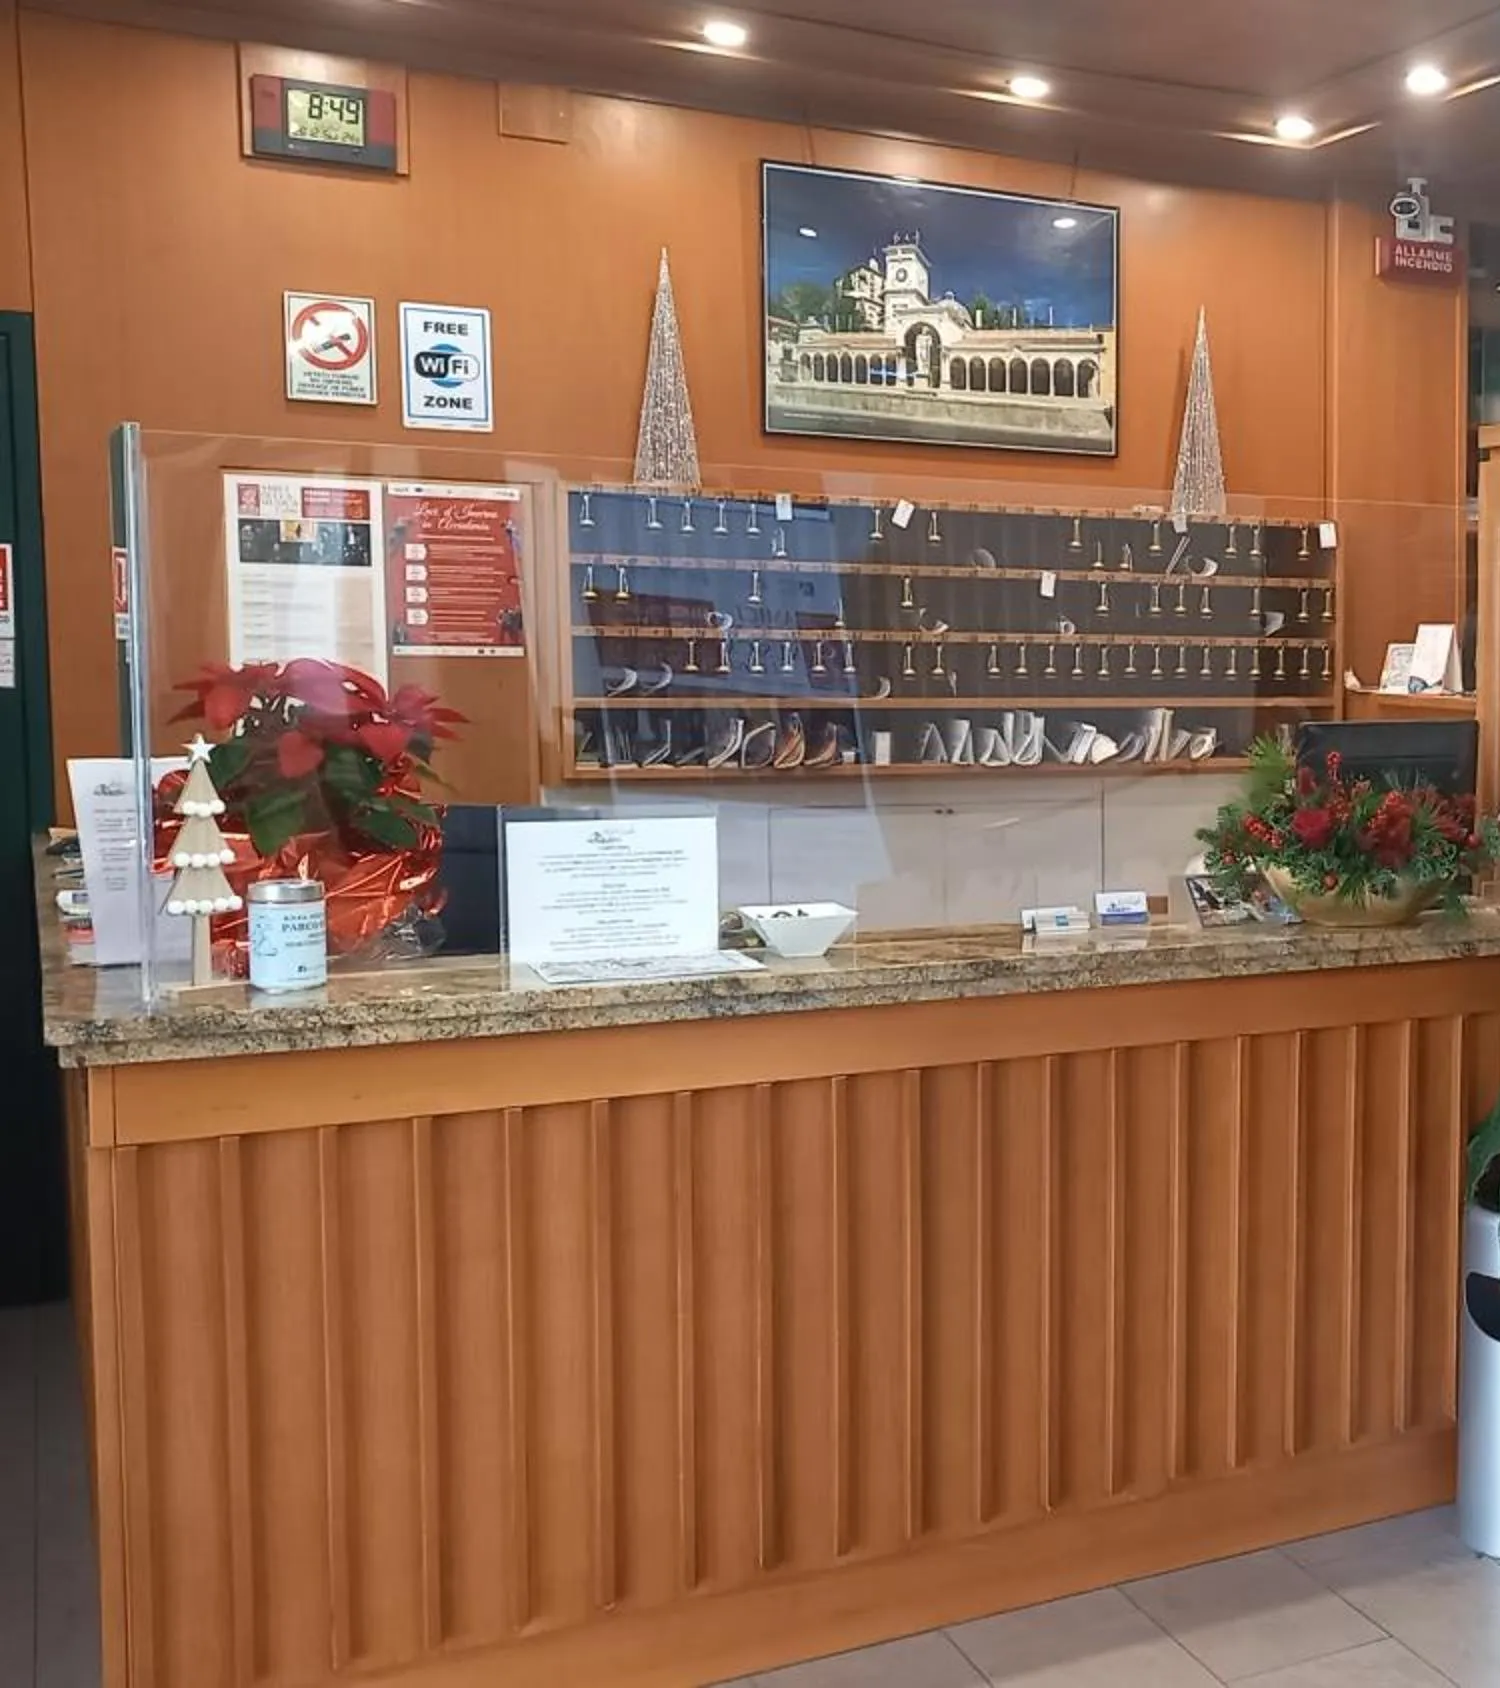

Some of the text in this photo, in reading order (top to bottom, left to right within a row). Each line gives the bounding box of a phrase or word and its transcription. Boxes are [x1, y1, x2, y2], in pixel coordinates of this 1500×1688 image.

[308, 93, 360, 125] 8:49
[1395, 244, 1453, 262] ALLARME
[1395, 256, 1453, 273] INCENDIO
[423, 321, 469, 336] FREE
[423, 395, 474, 410] ZONE
